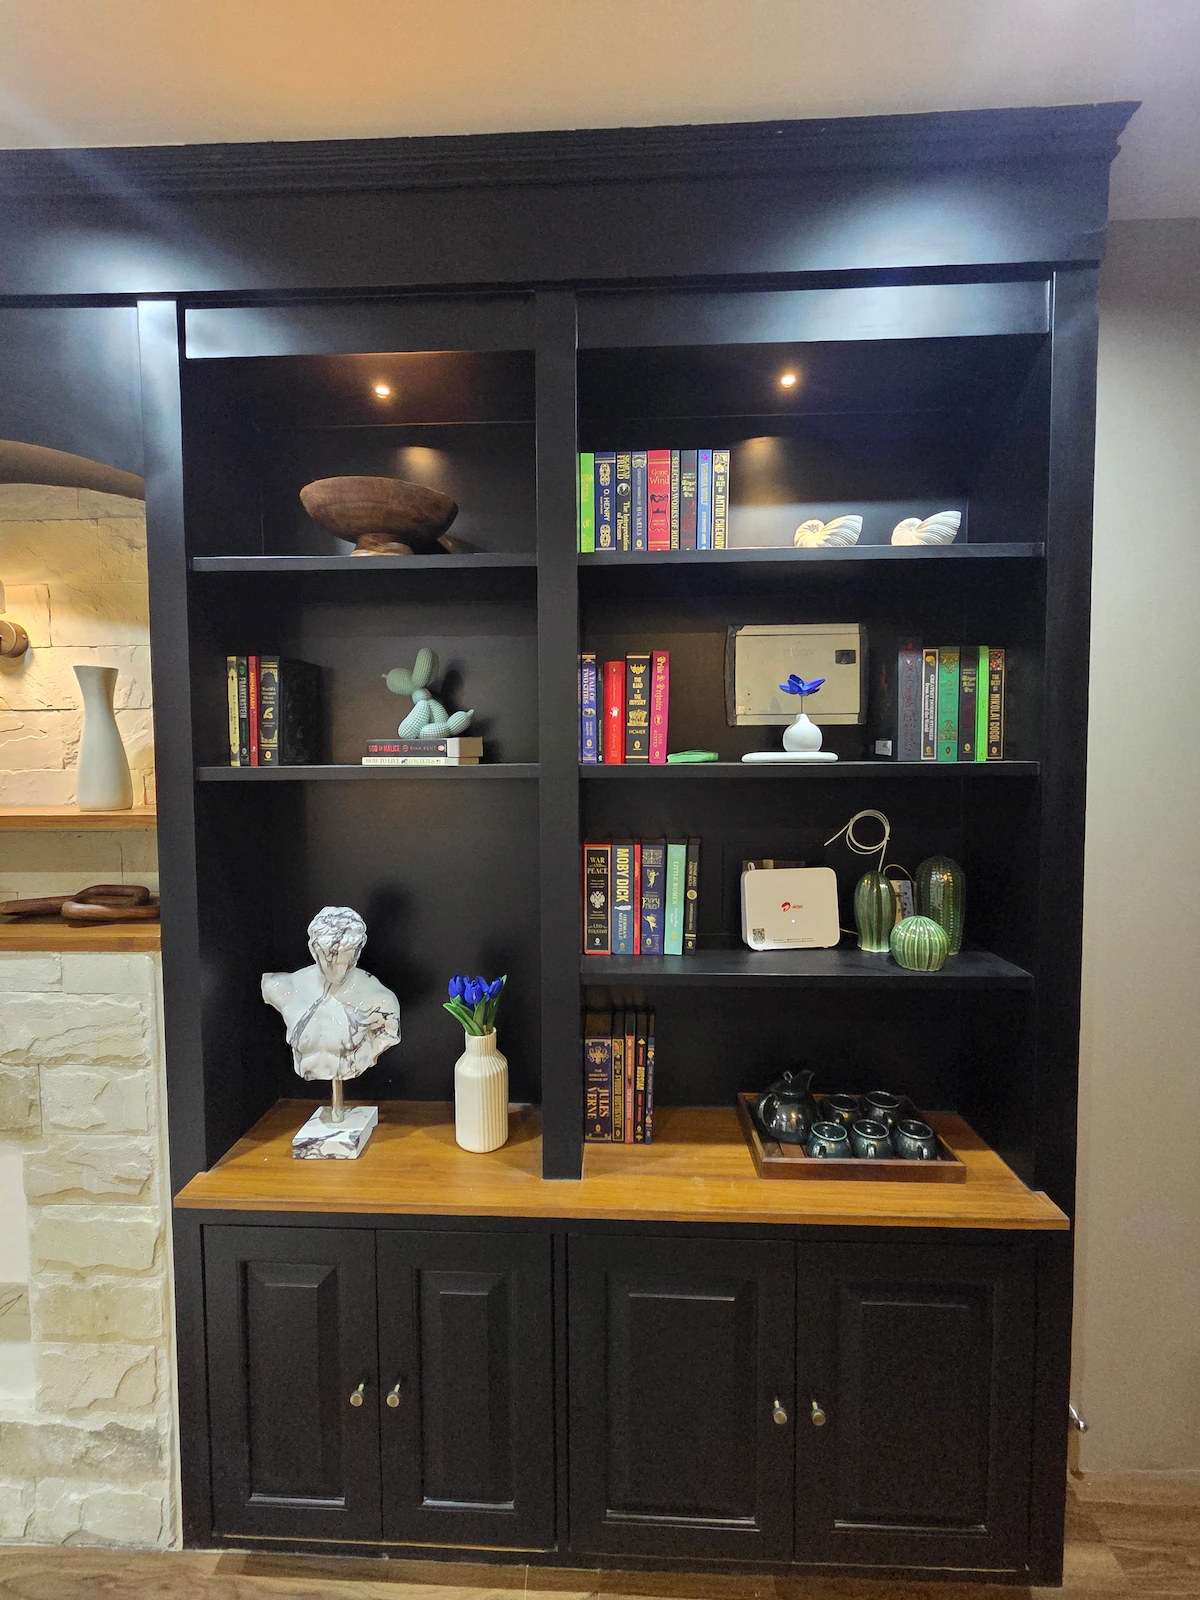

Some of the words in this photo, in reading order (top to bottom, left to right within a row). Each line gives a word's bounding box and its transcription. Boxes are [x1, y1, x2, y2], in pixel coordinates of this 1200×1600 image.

[649, 475, 670, 485] Wind
[700, 487, 708, 506] WOOLF
[715, 494, 725, 517] ANTON
[622, 513, 630, 551] Interpretation
[671, 520, 678, 529] OF
[715, 518, 725, 550] CHEKHOV
[656, 656, 666, 674] Pride
[239, 677, 247, 718] FRANKENSTEIN
[589, 692, 595, 701] OF
[655, 683, 665, 711] Prejudice
[989, 693, 1000, 720] NIKOLAI
[989, 721, 1000, 743] GOGOL
[384, 744, 400, 752] MALICE
[616, 848, 629, 877] MOBY
[616, 878, 629, 902] DICK
[614, 1074, 622, 1095] FYODOR
[637, 1066, 645, 1090] RUSSIAN
[587, 1086, 597, 1119] VERNE
[597, 1087, 609, 1118] JULES
